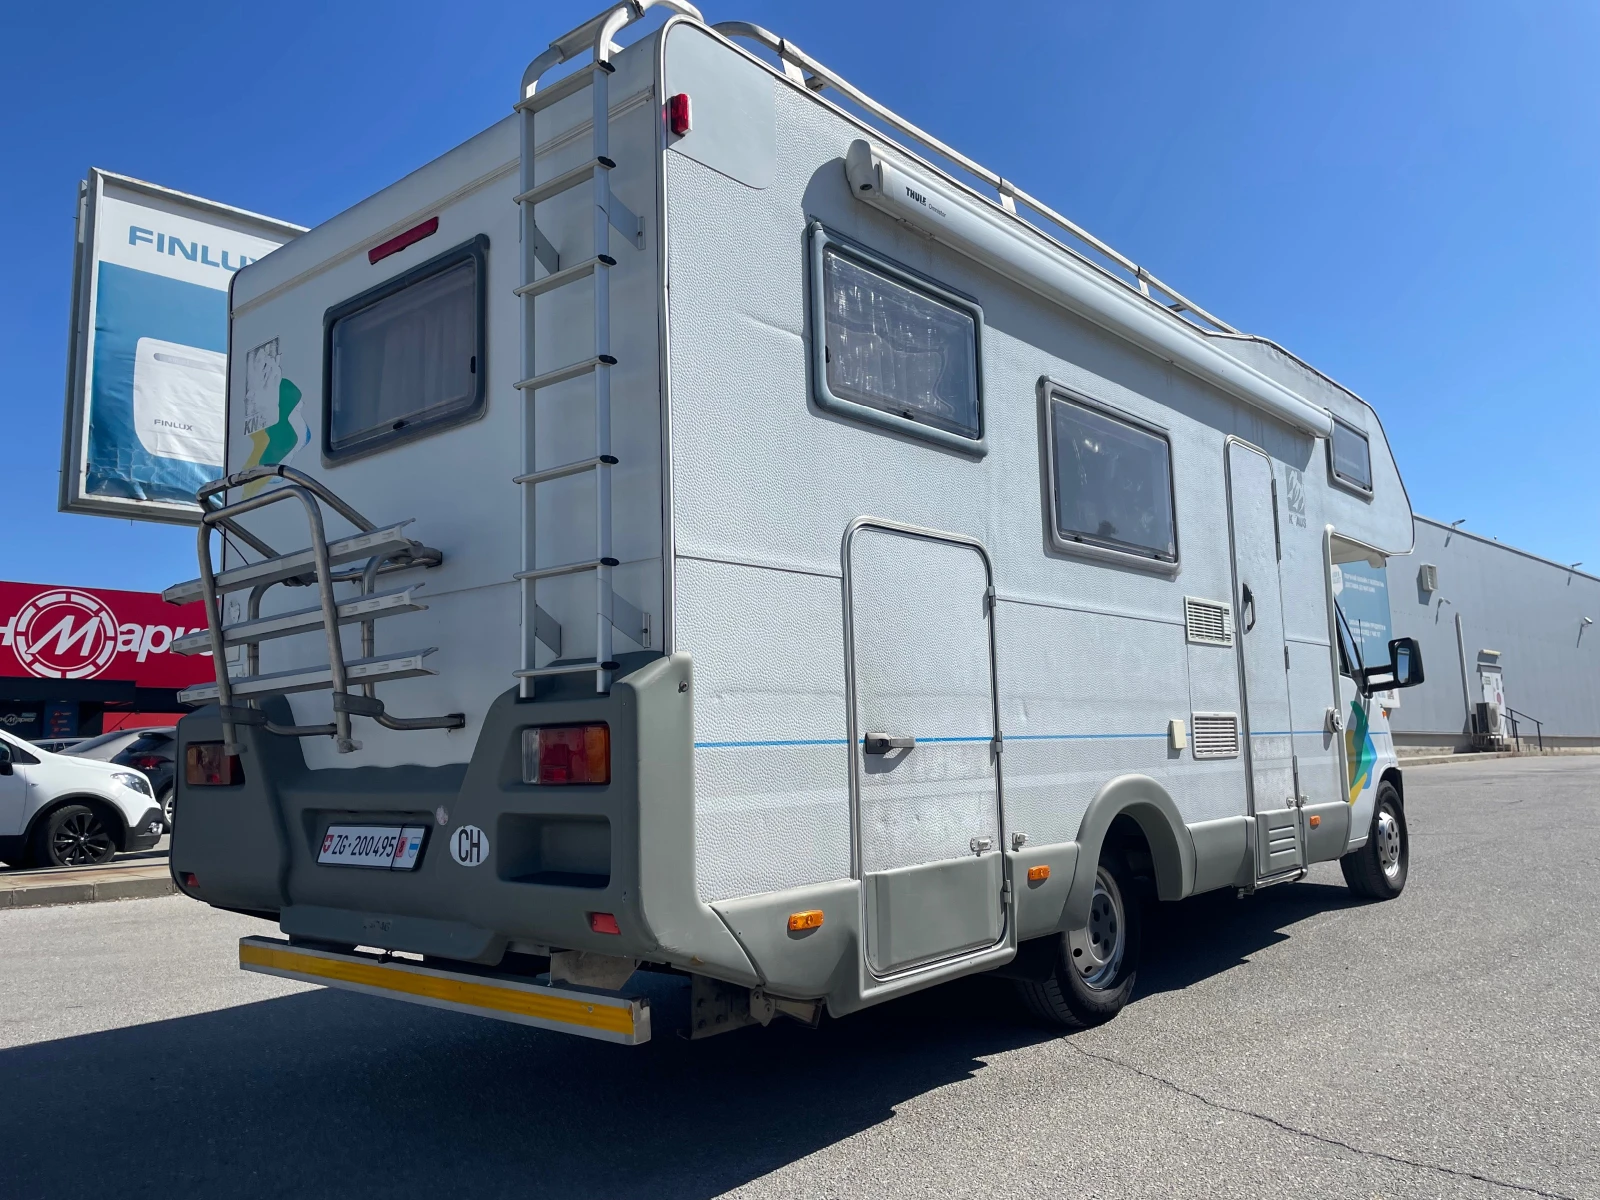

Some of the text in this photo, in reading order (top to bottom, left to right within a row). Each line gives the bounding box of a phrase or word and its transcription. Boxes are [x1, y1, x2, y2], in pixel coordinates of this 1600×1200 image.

[905, 186, 927, 205] THULE
[128, 225, 257, 273] FINLU
[154, 418, 193, 431] FINLUX
[1288, 513, 1307, 529] KAUS
[458, 829, 481, 863] CH
